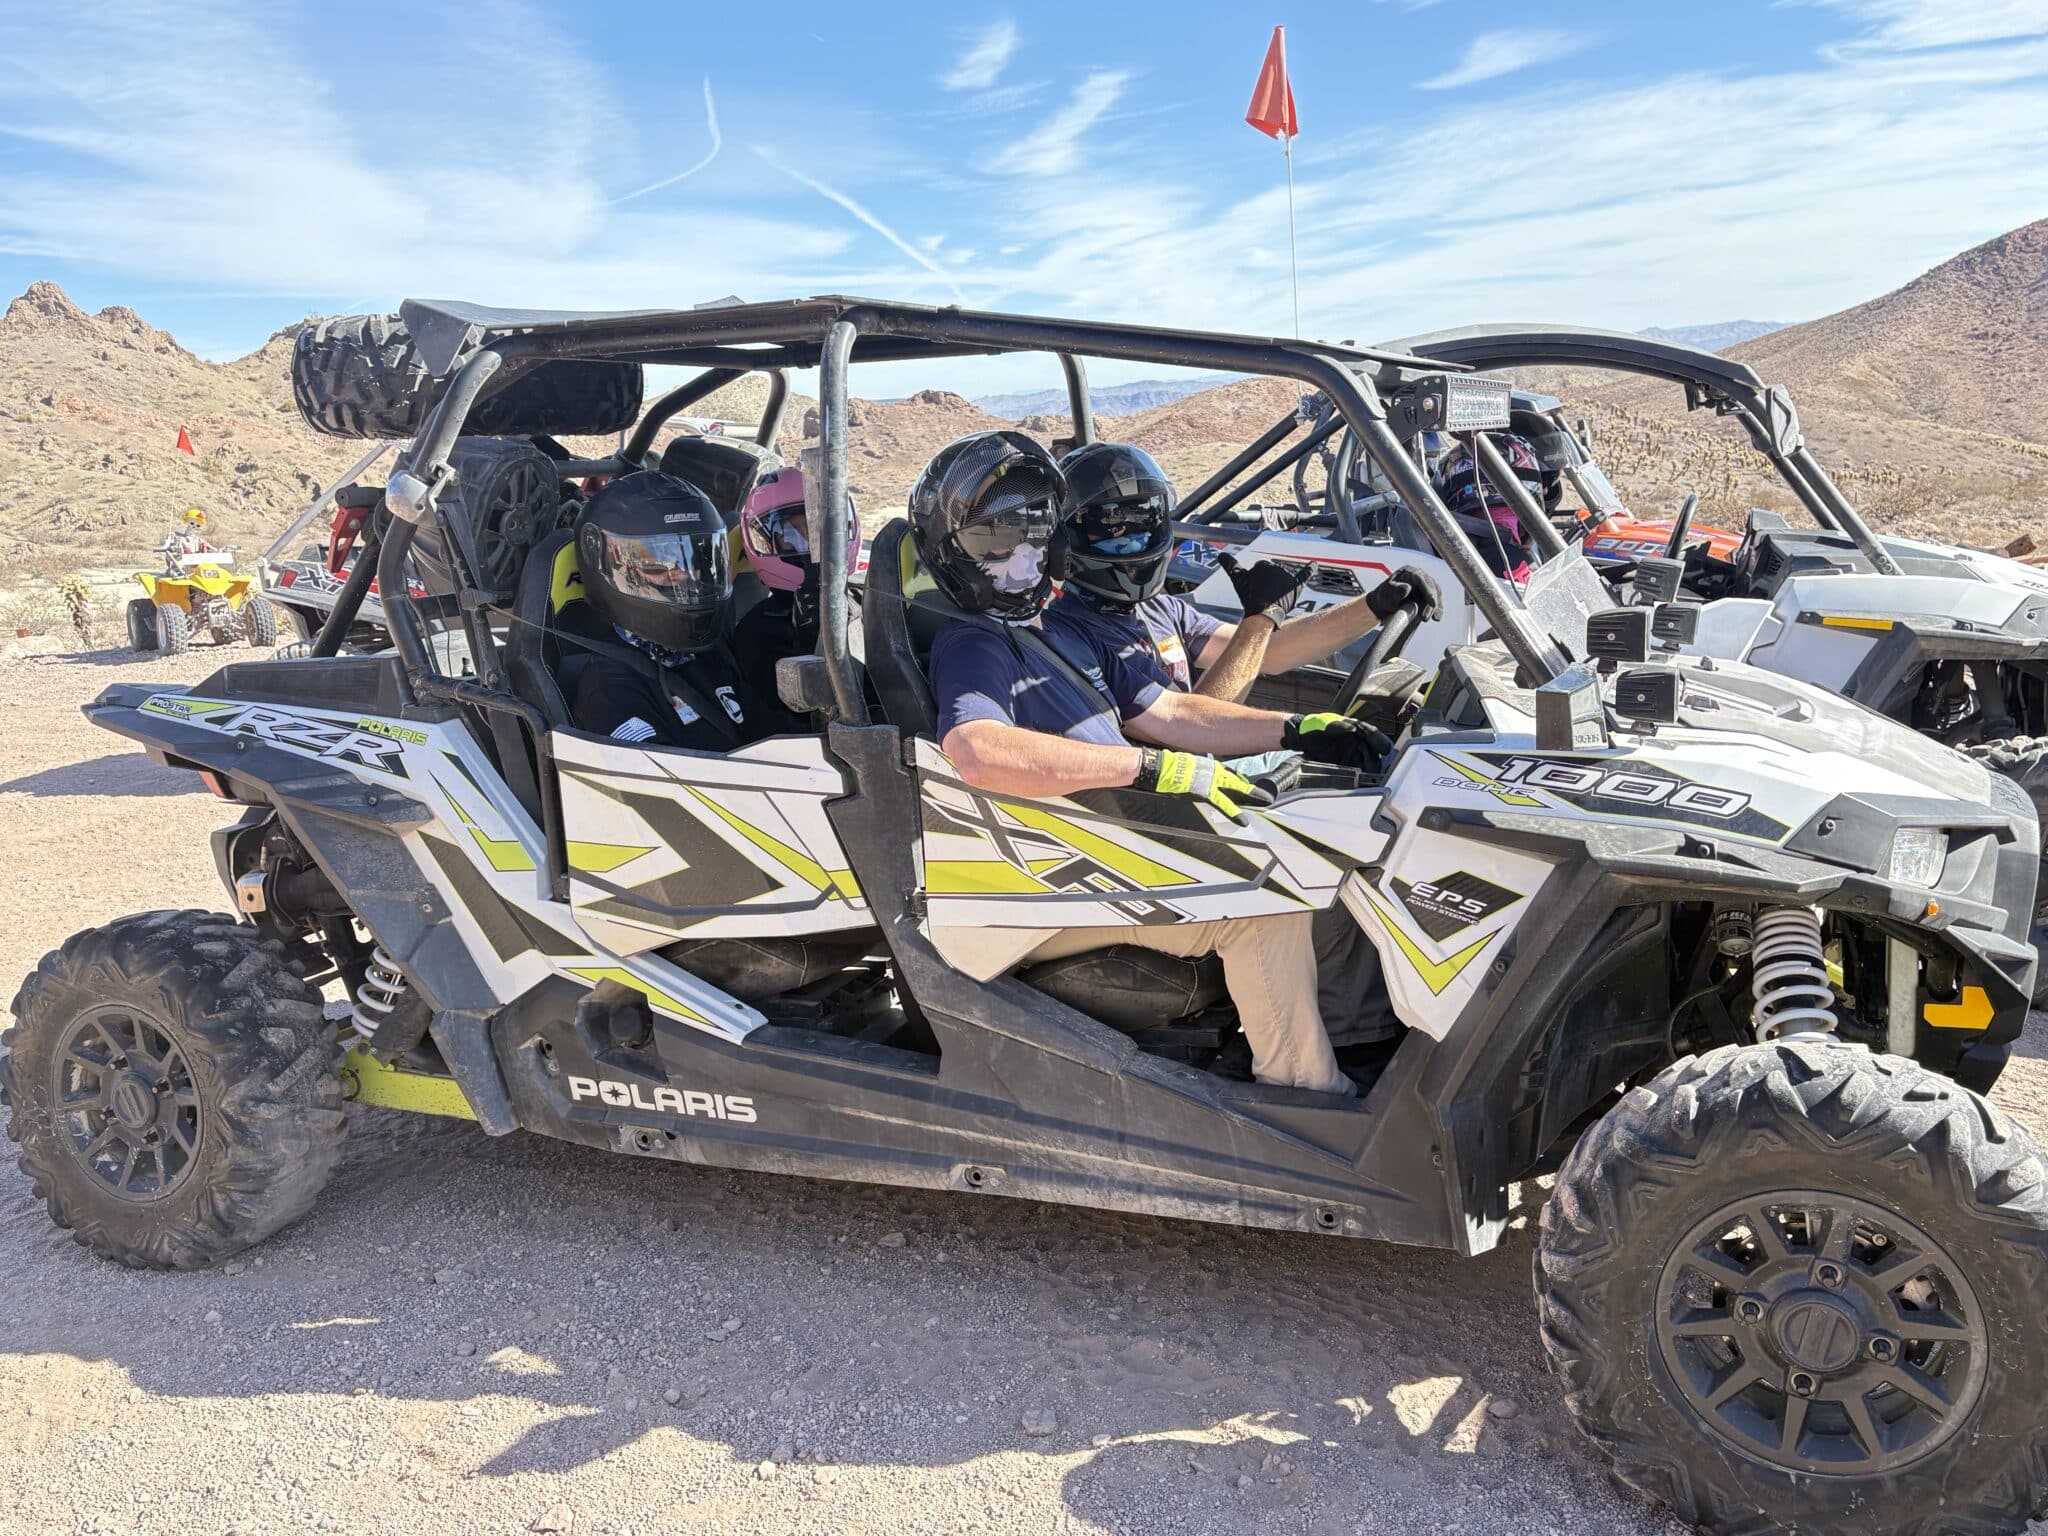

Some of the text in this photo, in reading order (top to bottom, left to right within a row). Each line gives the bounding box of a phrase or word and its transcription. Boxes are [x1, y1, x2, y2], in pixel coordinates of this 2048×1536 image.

[150, 697, 193, 713] PROSTAR
[220, 706, 405, 774] RZR
[356, 717, 429, 747] POLARIS
[1432, 777, 1536, 798] DOHC
[1495, 756, 1752, 817] 1000
[1405, 898, 1438, 911] POWER
[1411, 881, 1488, 914] EPS
[568, 1076, 758, 1123] POLARIS
